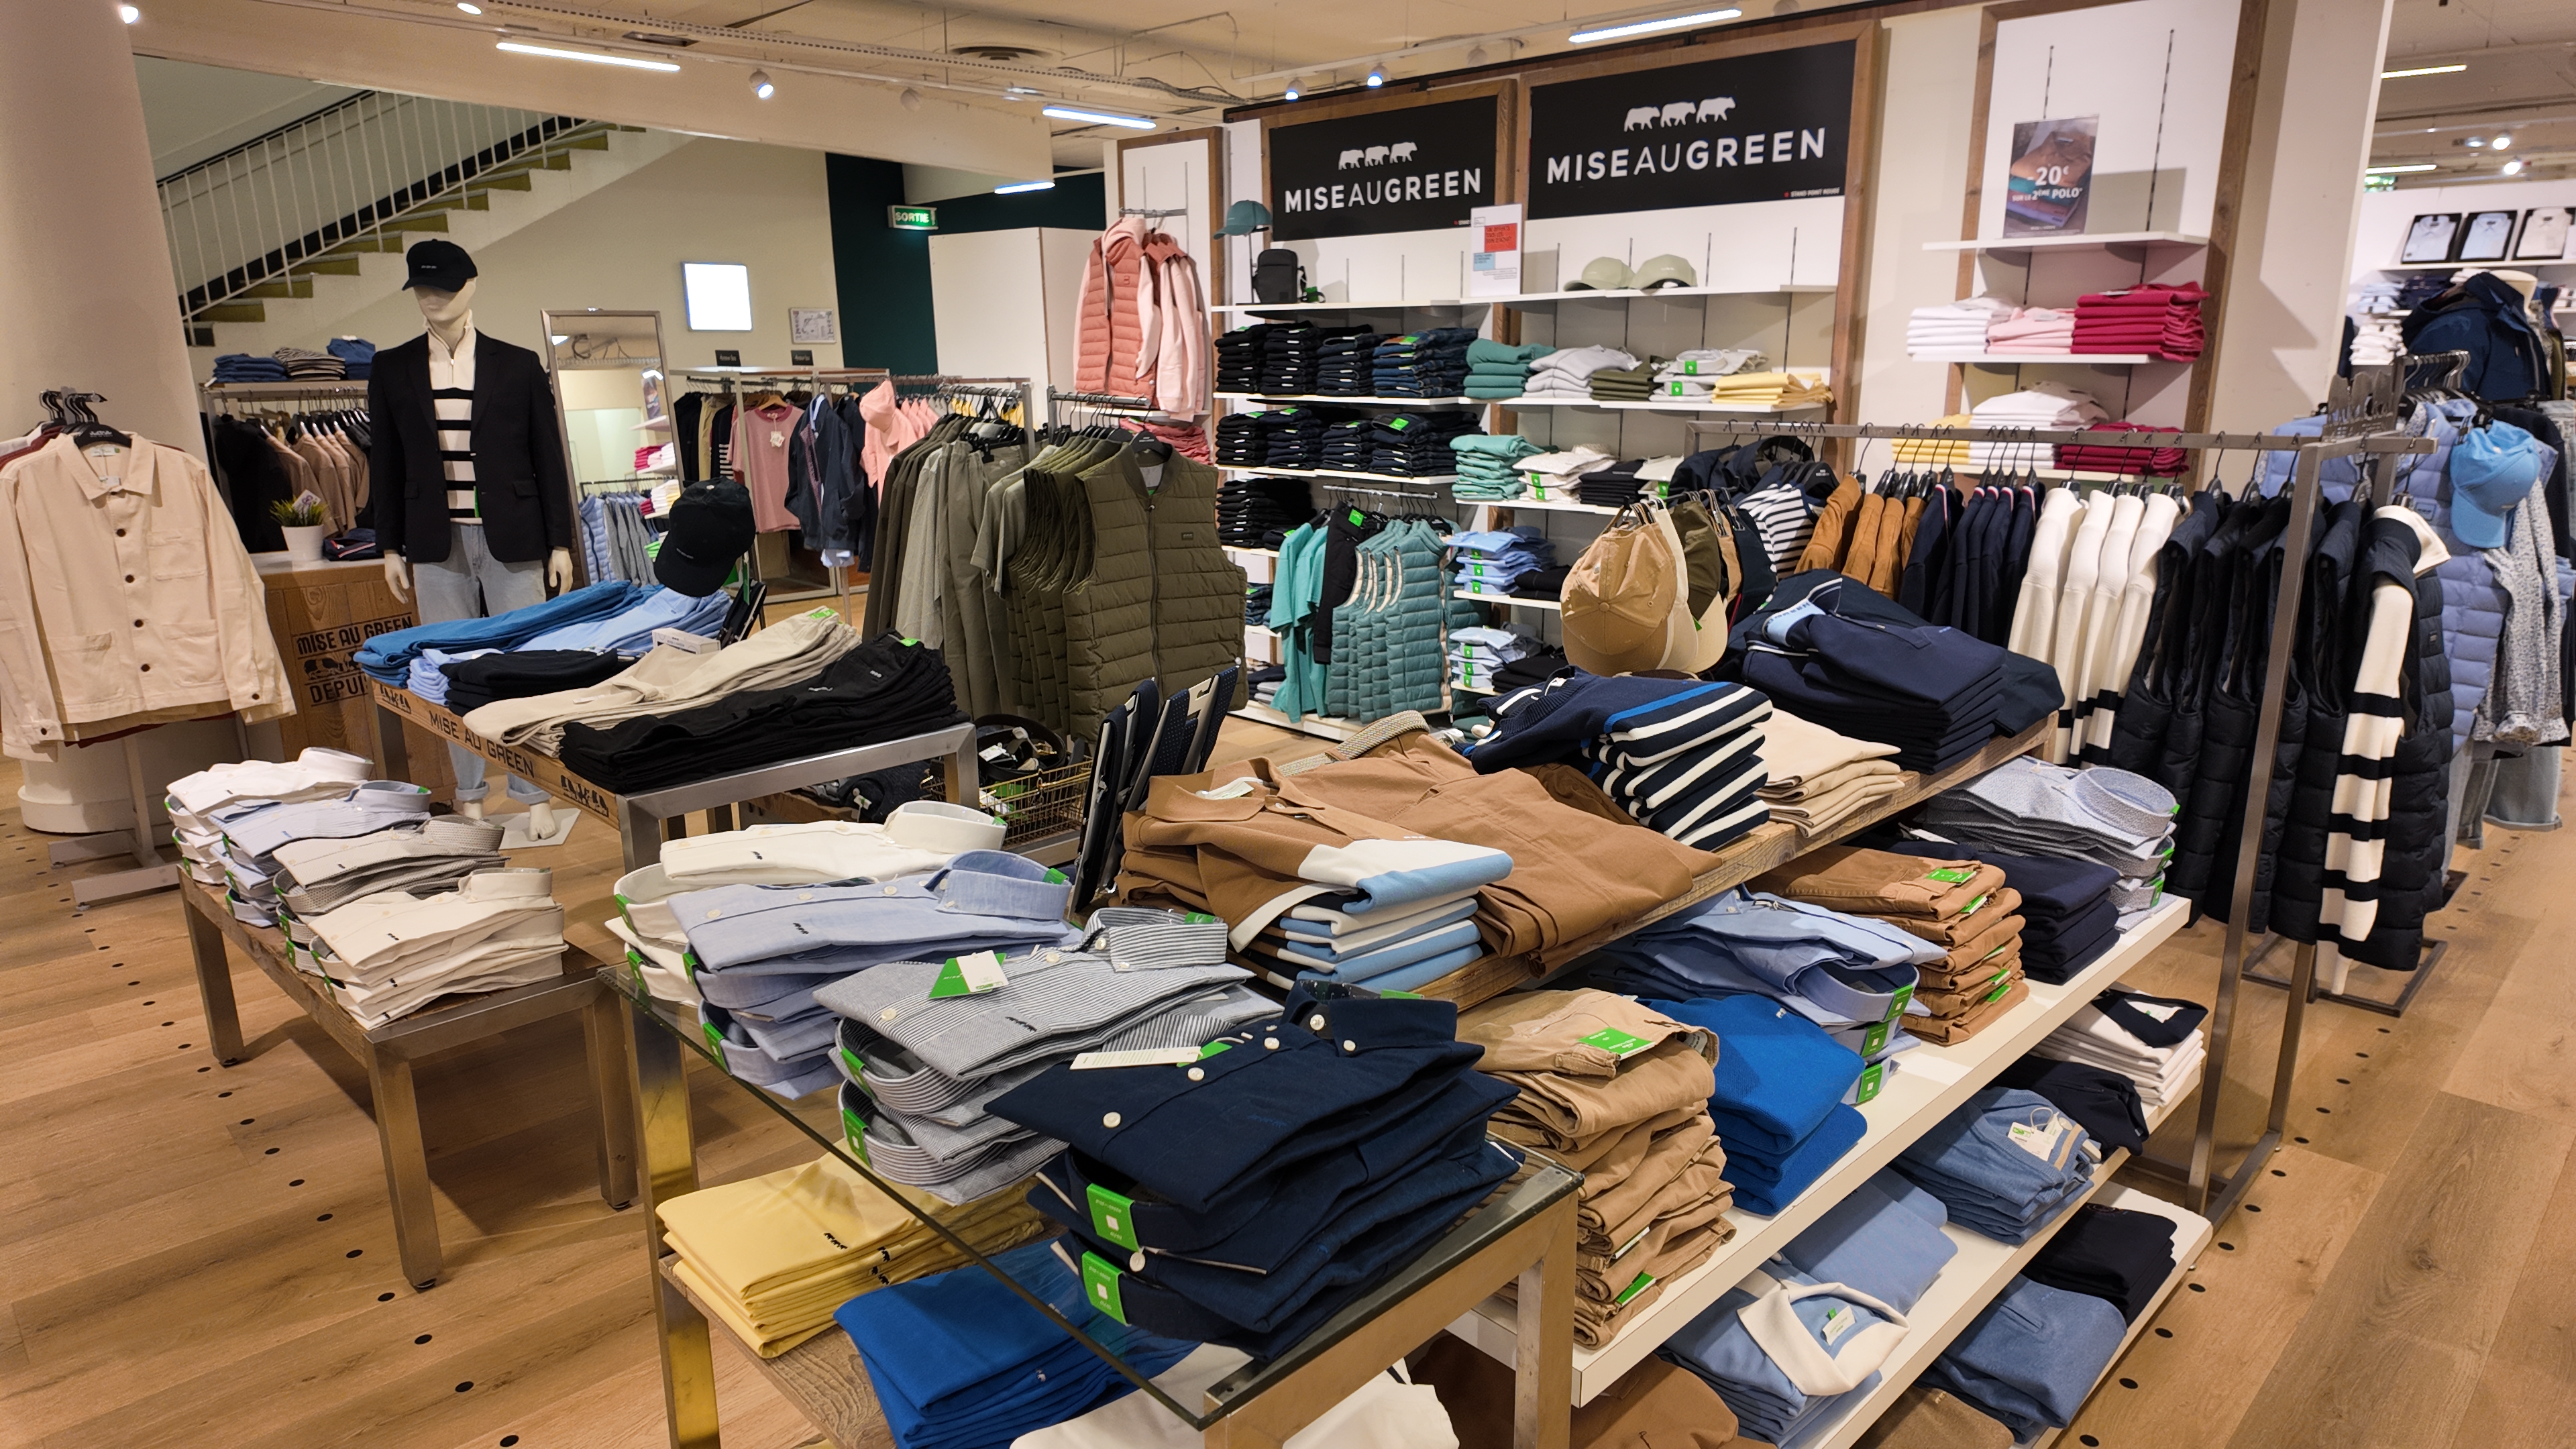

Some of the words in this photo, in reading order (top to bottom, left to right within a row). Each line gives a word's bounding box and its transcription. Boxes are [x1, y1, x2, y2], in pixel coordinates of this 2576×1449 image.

[895, 211, 930, 223] SORTIE
[297, 631, 337, 655] MISE
[339, 626, 362, 647] AU
[429, 710, 460, 739] MISE
[465, 731, 482, 751] AU
[487, 740, 535, 779] GREEN
